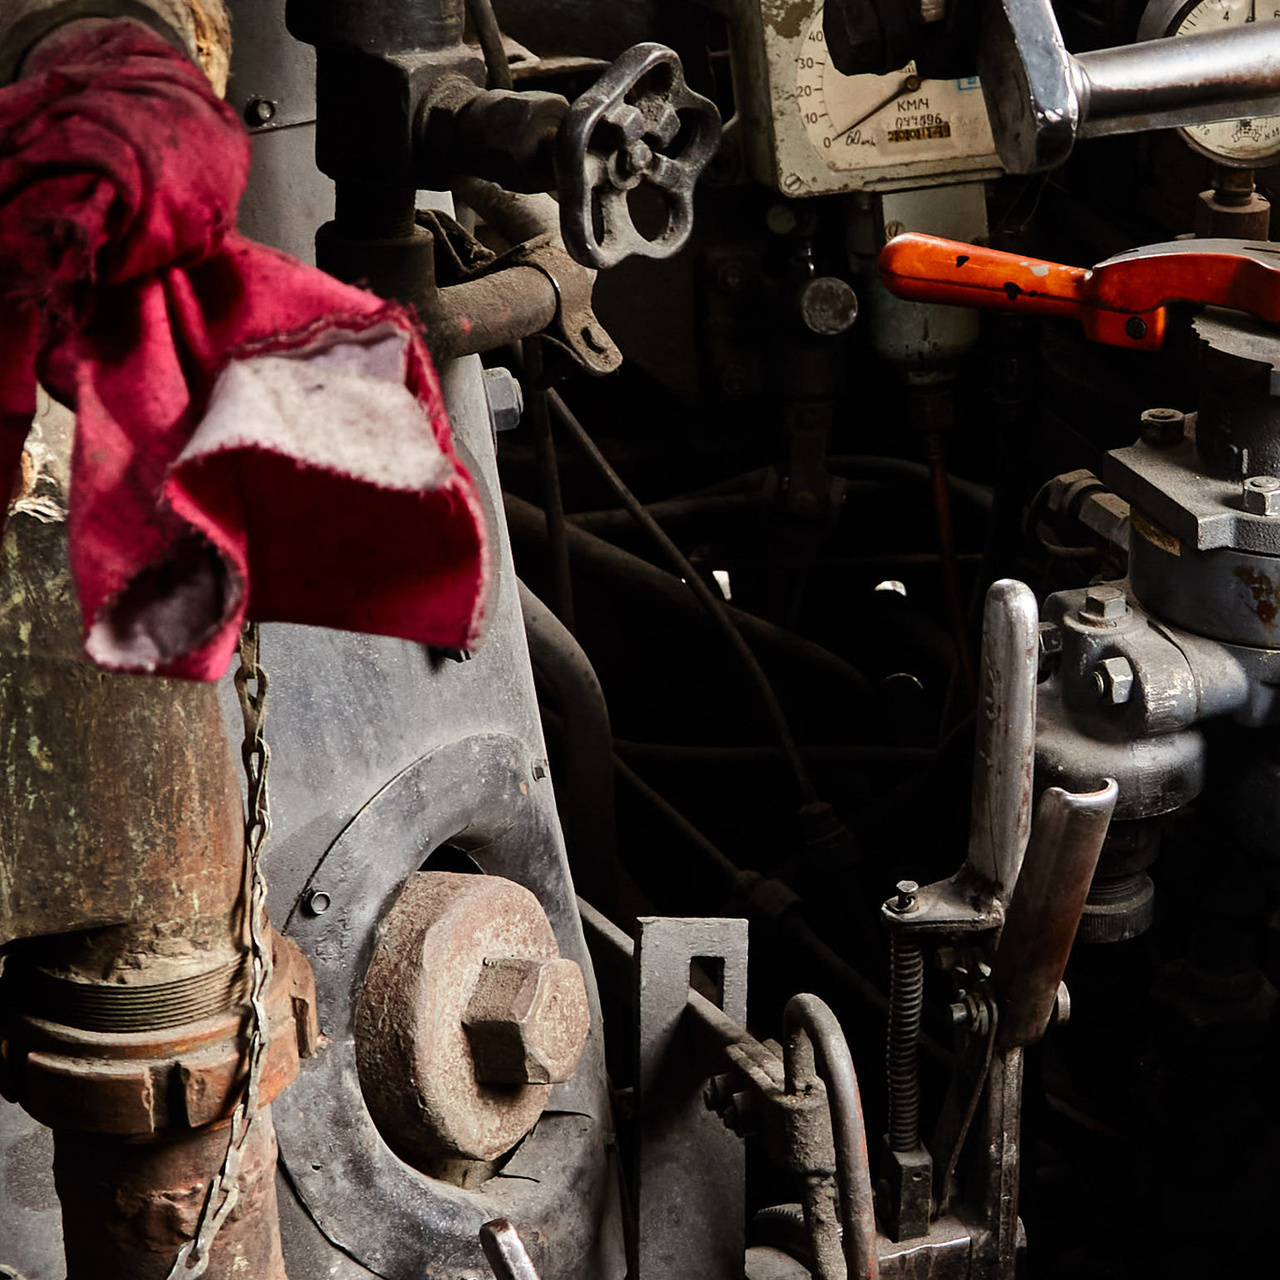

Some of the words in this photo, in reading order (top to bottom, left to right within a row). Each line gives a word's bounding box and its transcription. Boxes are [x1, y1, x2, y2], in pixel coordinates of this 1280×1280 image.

[1222, 10, 1230, 22] 4
[808, 30, 823, 42] 40
[799, 57, 814, 69] 30
[797, 85, 812, 98] 20
[805, 112, 818, 124] 10
[823, 137, 832, 149] 0
